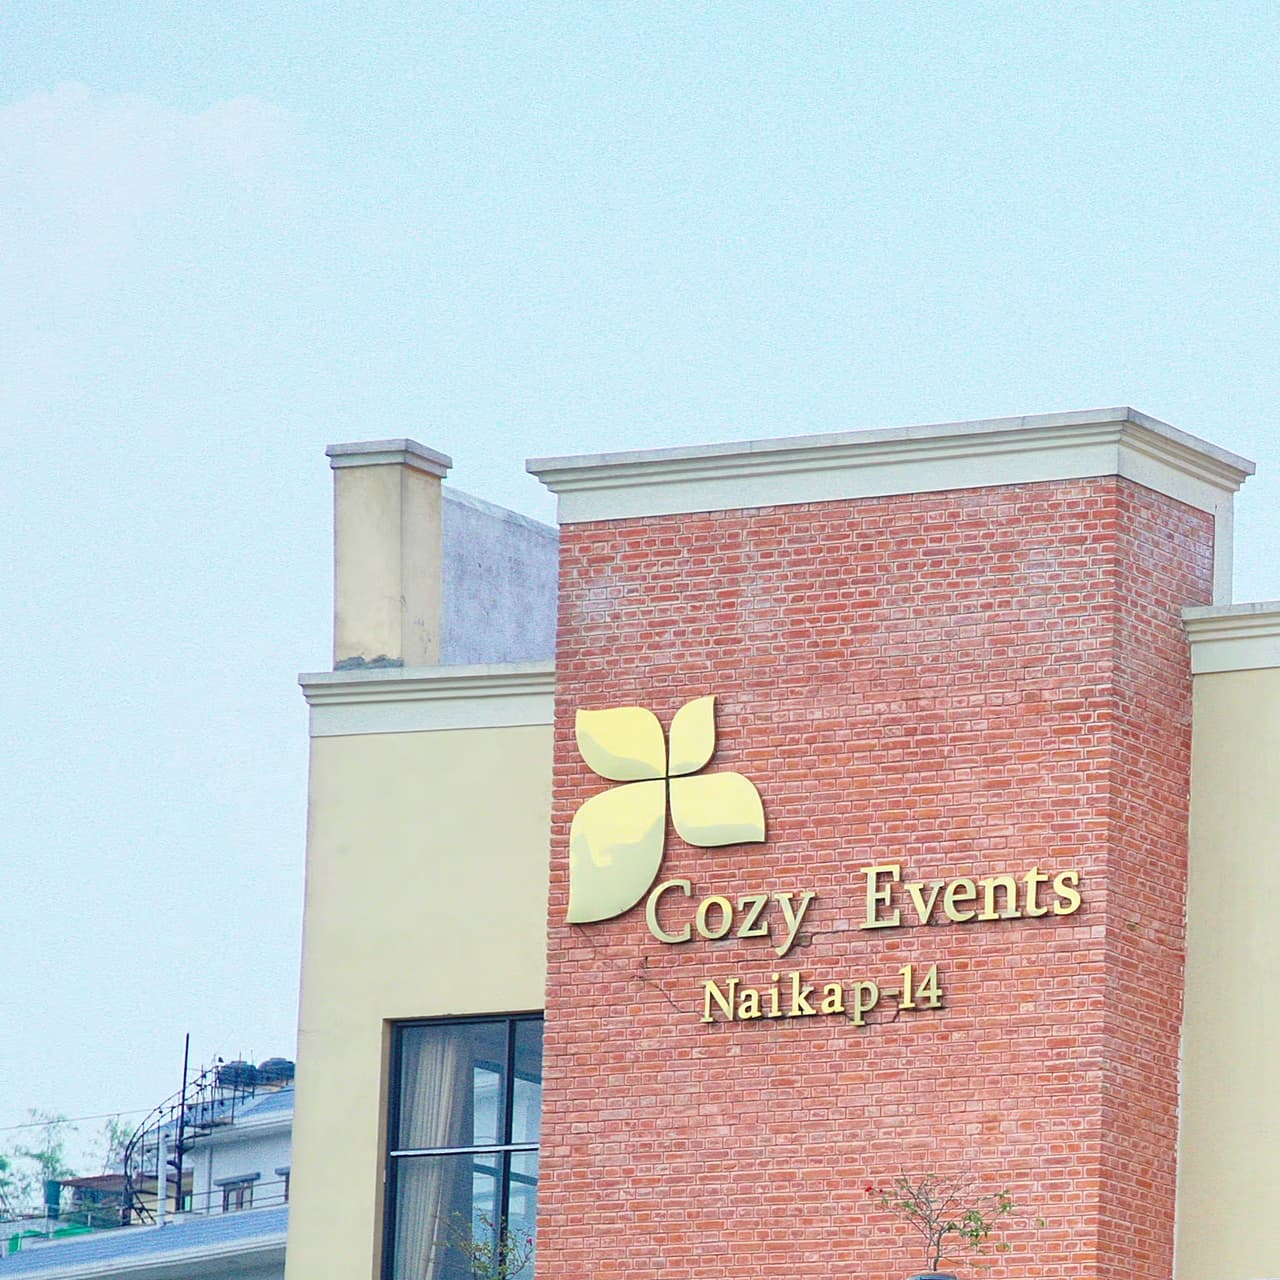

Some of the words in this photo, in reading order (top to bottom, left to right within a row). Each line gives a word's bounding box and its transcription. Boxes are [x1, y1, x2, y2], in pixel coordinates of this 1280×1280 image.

[645, 878, 817, 957] Cozy
[859, 864, 1082, 930] Events
[700, 963, 943, 1026] Naikap-14
